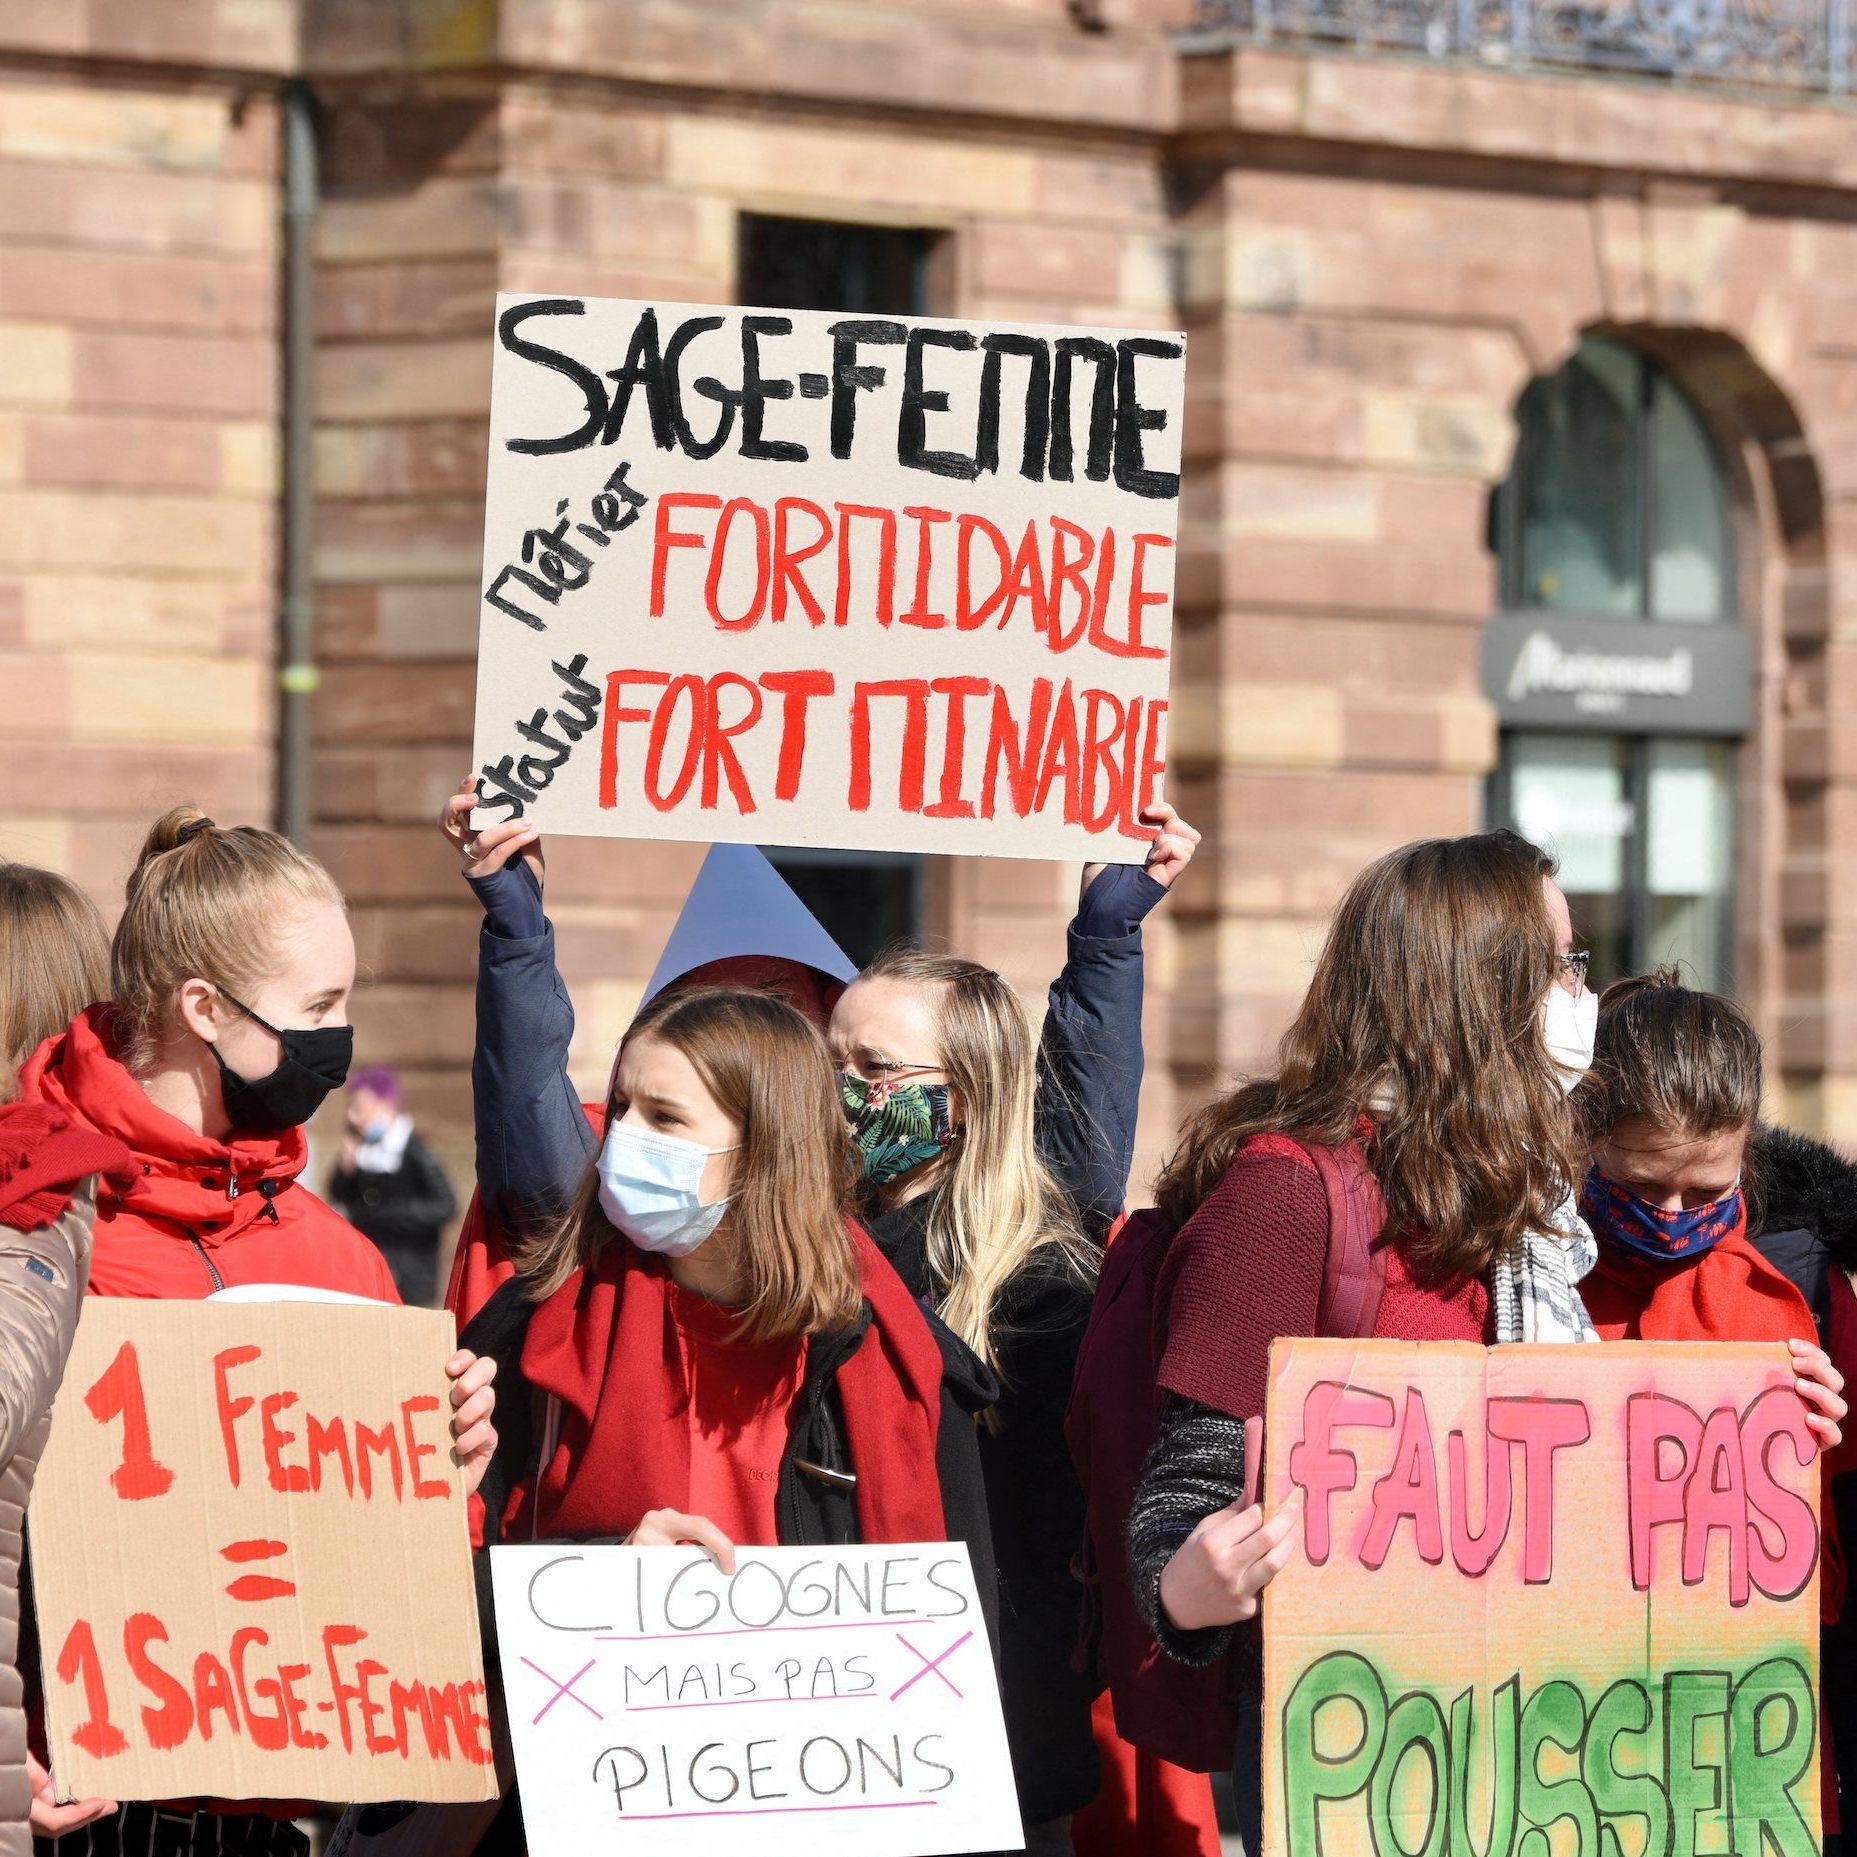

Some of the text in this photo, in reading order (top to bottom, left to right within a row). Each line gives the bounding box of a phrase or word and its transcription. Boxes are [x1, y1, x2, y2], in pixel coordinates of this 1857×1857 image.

[499, 298, 1185, 499] SAGE-FEMME
[650, 492, 1173, 659] FORMIDABLE
[599, 670, 834, 815] FORT
[848, 676, 1168, 841] MINABLE
[84, 1341, 176, 1500] 1
[1289, 1379, 1820, 1608] FAUT PAS
[527, 1555, 969, 1633] CIGOGNES
[57, 1618, 130, 1760] 1
[624, 1655, 876, 1703] MAIS PAS
[1281, 1649, 1819, 1857] POUSSER
[592, 1733, 955, 1811] PIGEONS
